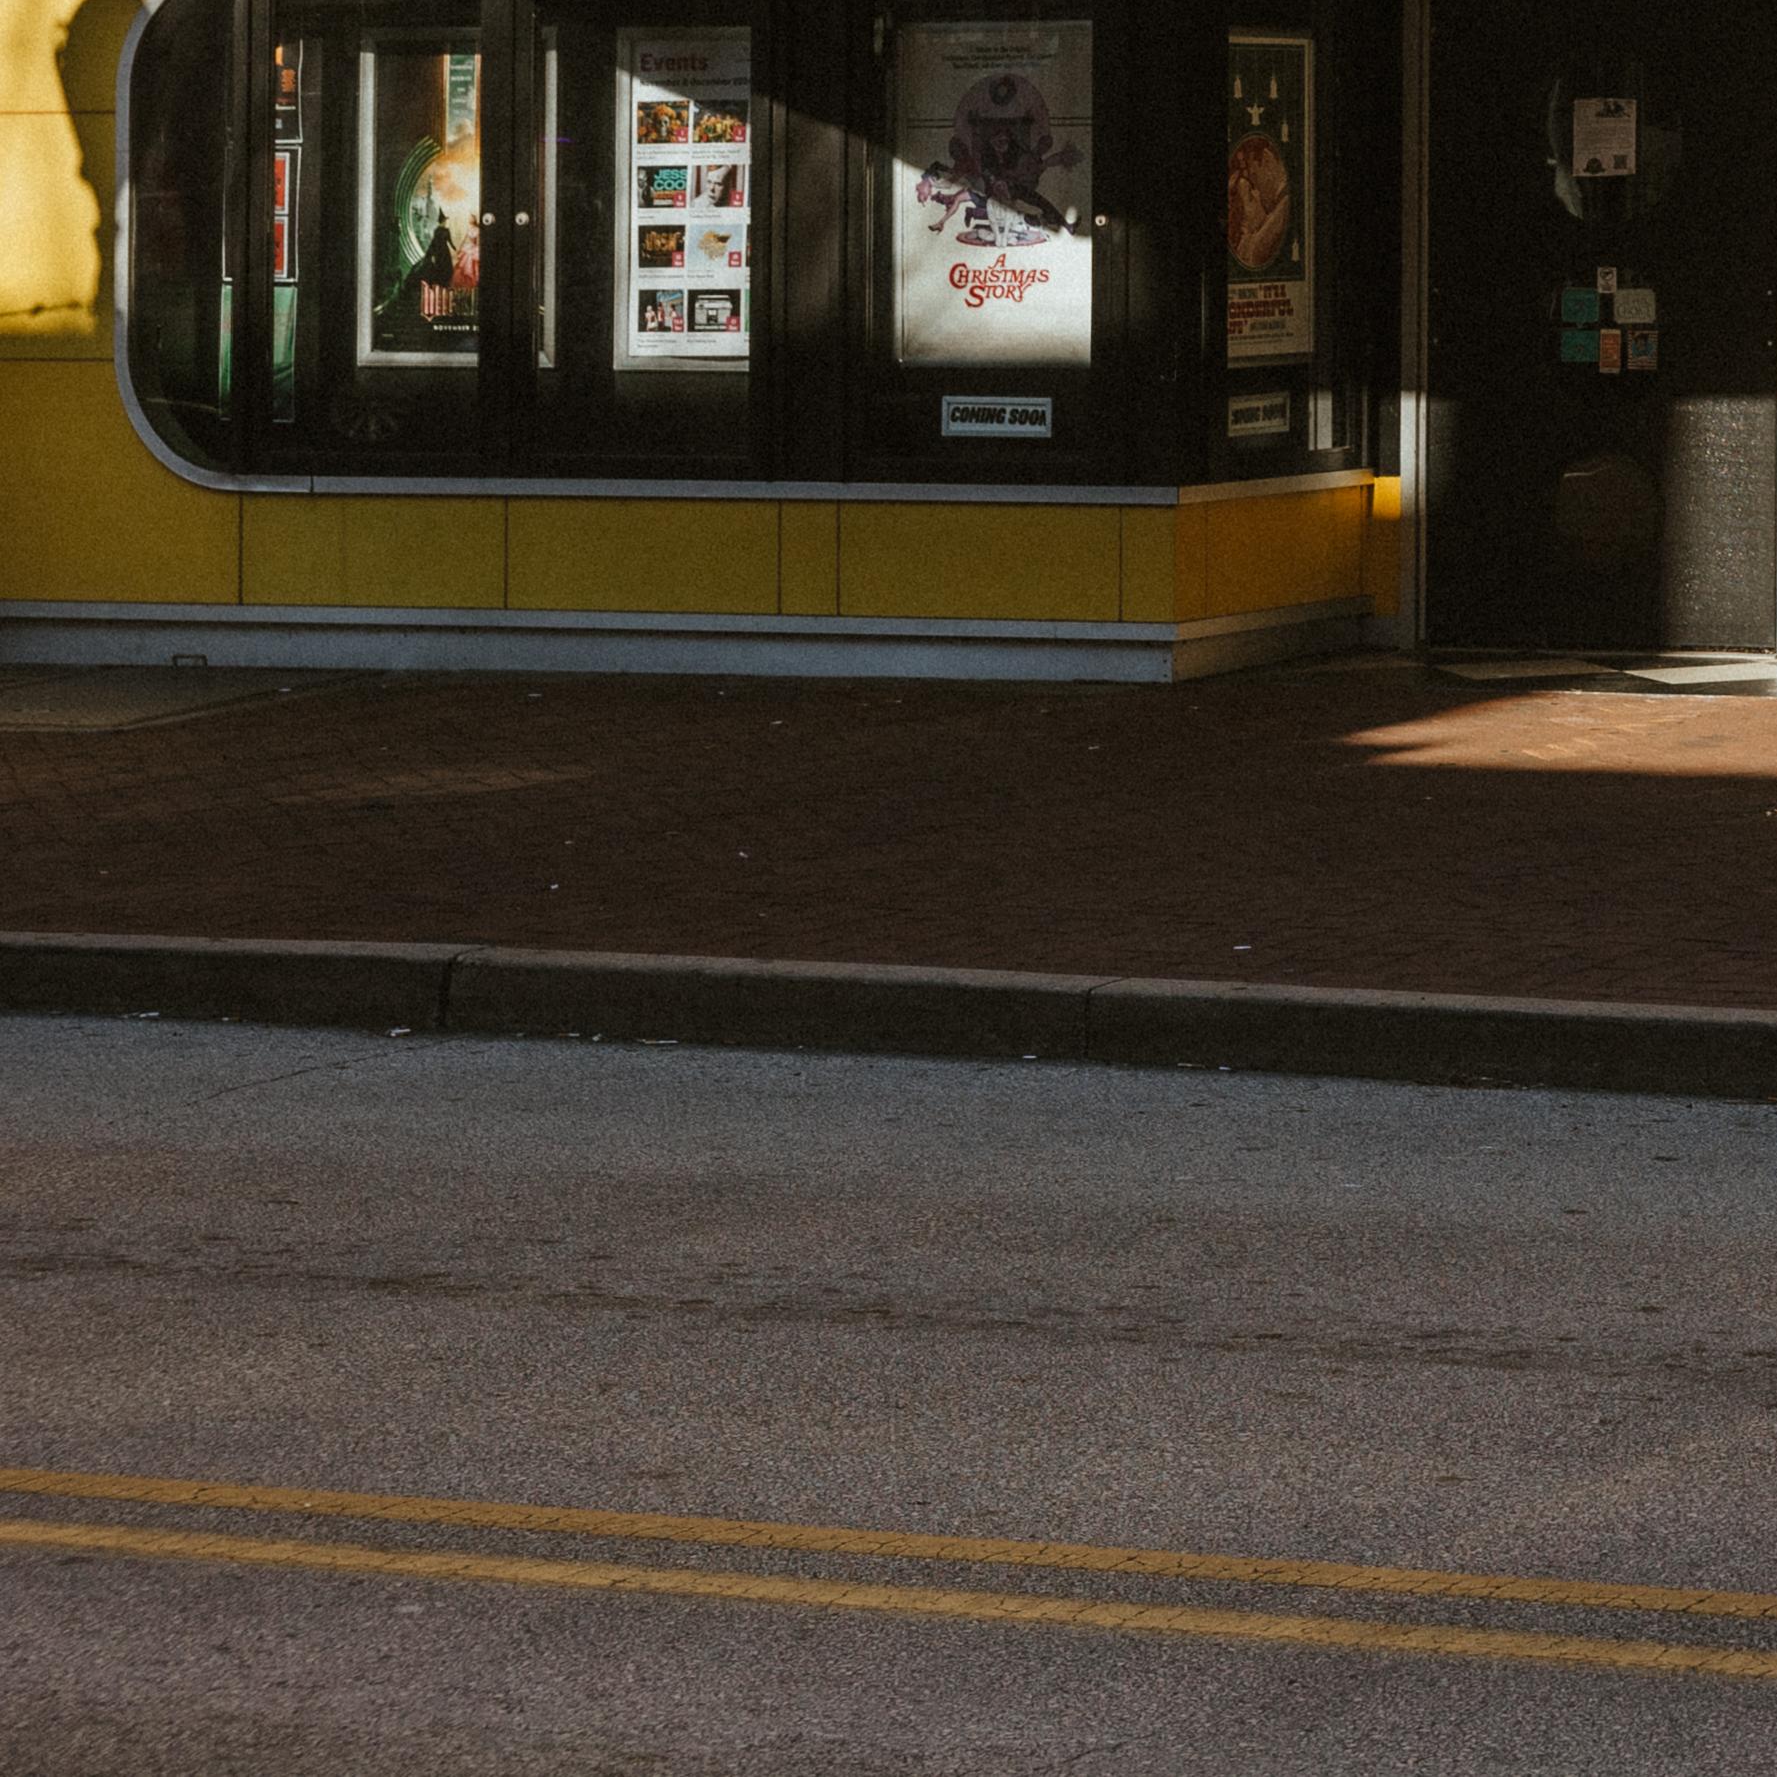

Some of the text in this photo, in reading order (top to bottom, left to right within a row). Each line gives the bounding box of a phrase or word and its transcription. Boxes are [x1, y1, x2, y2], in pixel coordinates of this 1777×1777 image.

[988, 253, 1007, 269] A
[949, 262, 1050, 289] CHRISTMAS
[964, 283, 1032, 308] STORY
[950, 406, 1006, 424] COMING
